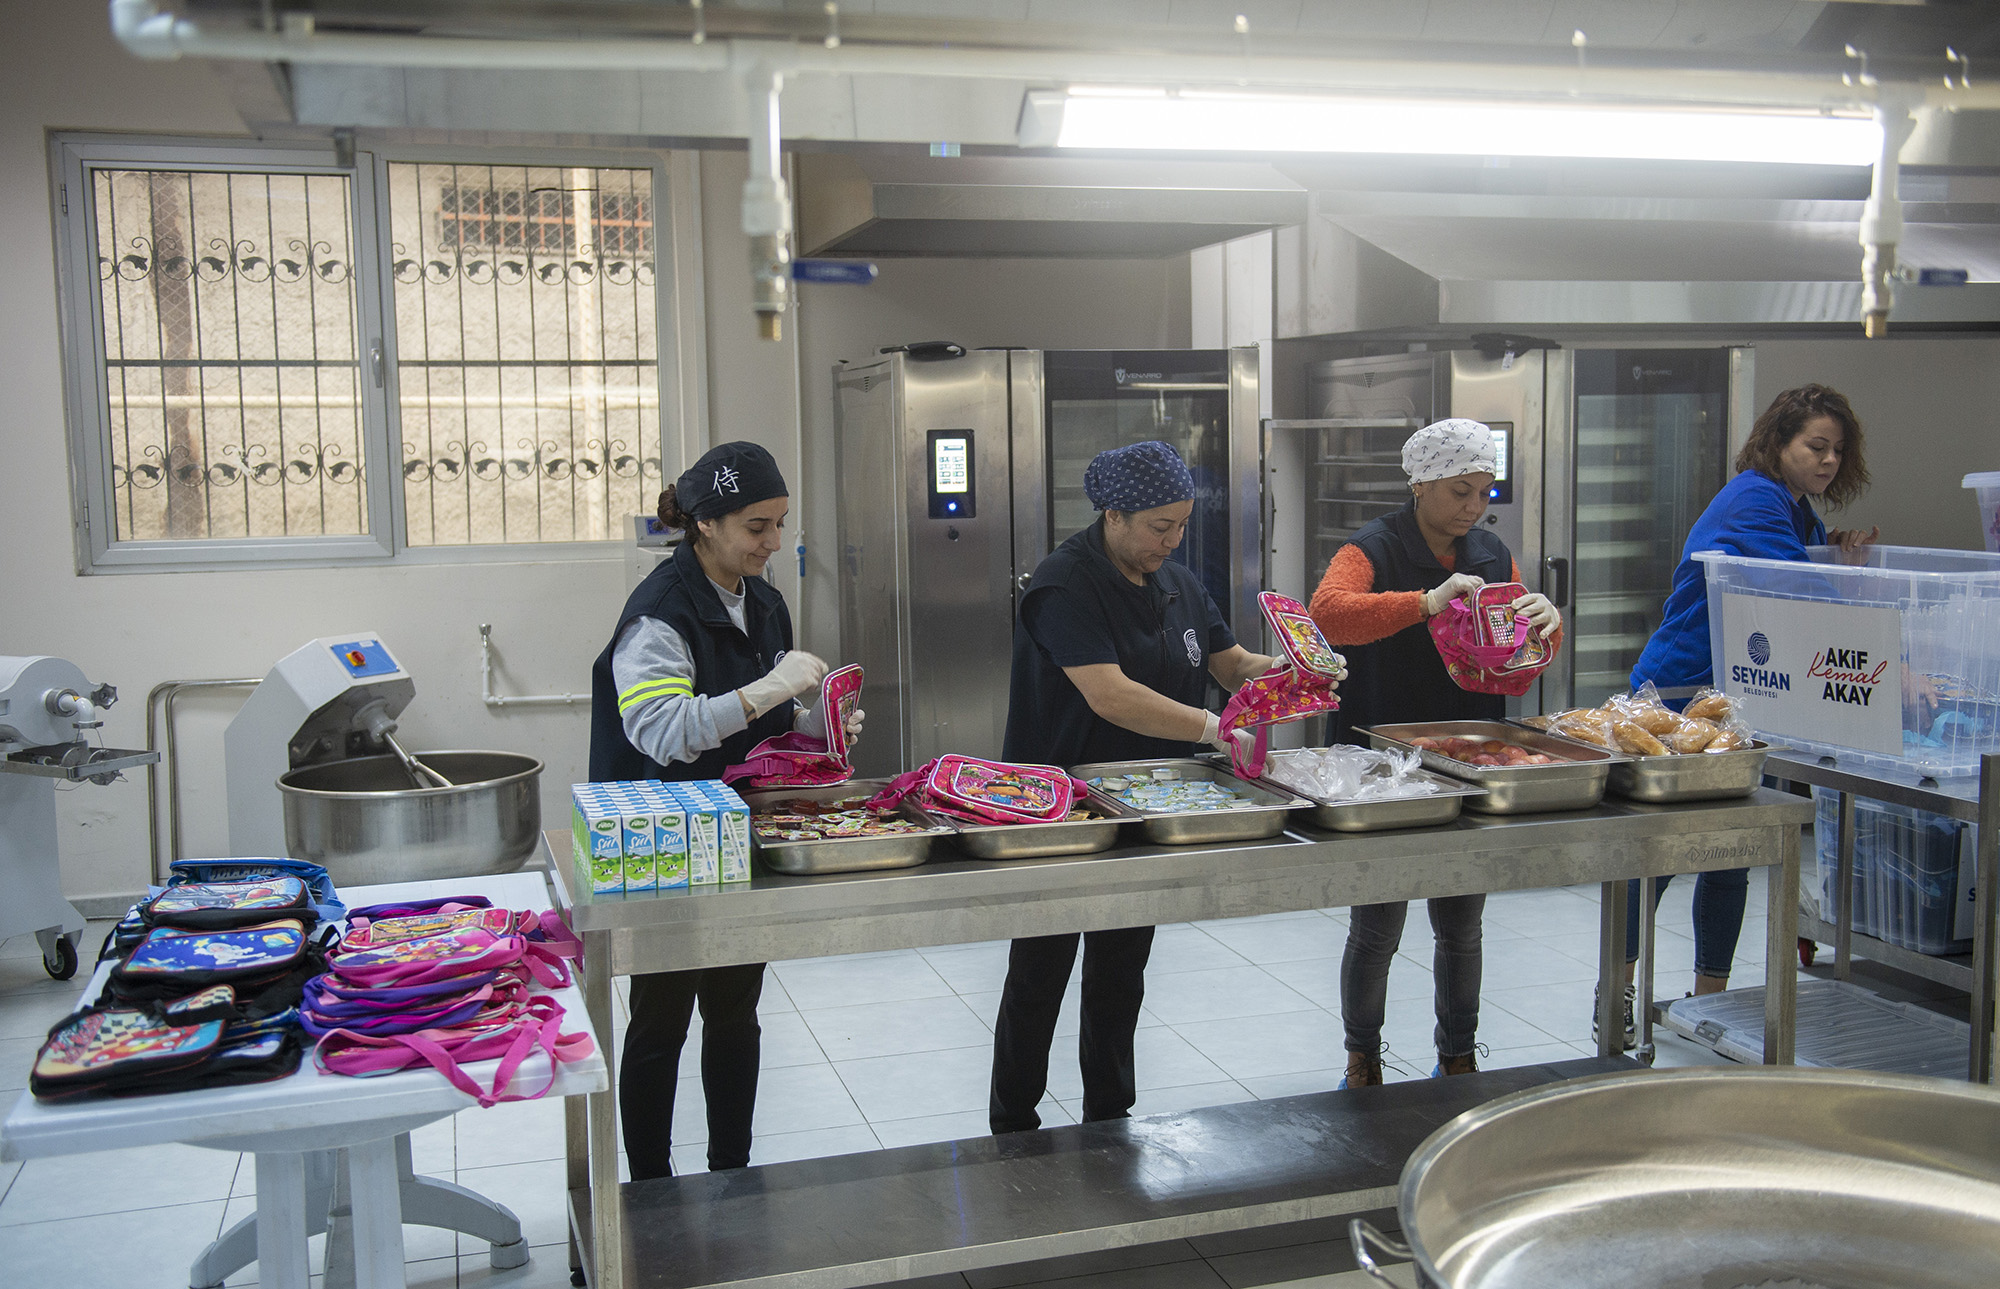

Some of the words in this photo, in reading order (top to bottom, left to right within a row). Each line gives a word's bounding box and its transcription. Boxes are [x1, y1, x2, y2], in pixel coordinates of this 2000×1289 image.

[713, 465, 740, 497] 侍
[1732, 665, 1790, 691] SEYHAN
[1807, 652, 1888, 685] Kemal
[1823, 681, 1873, 706] AKAY
